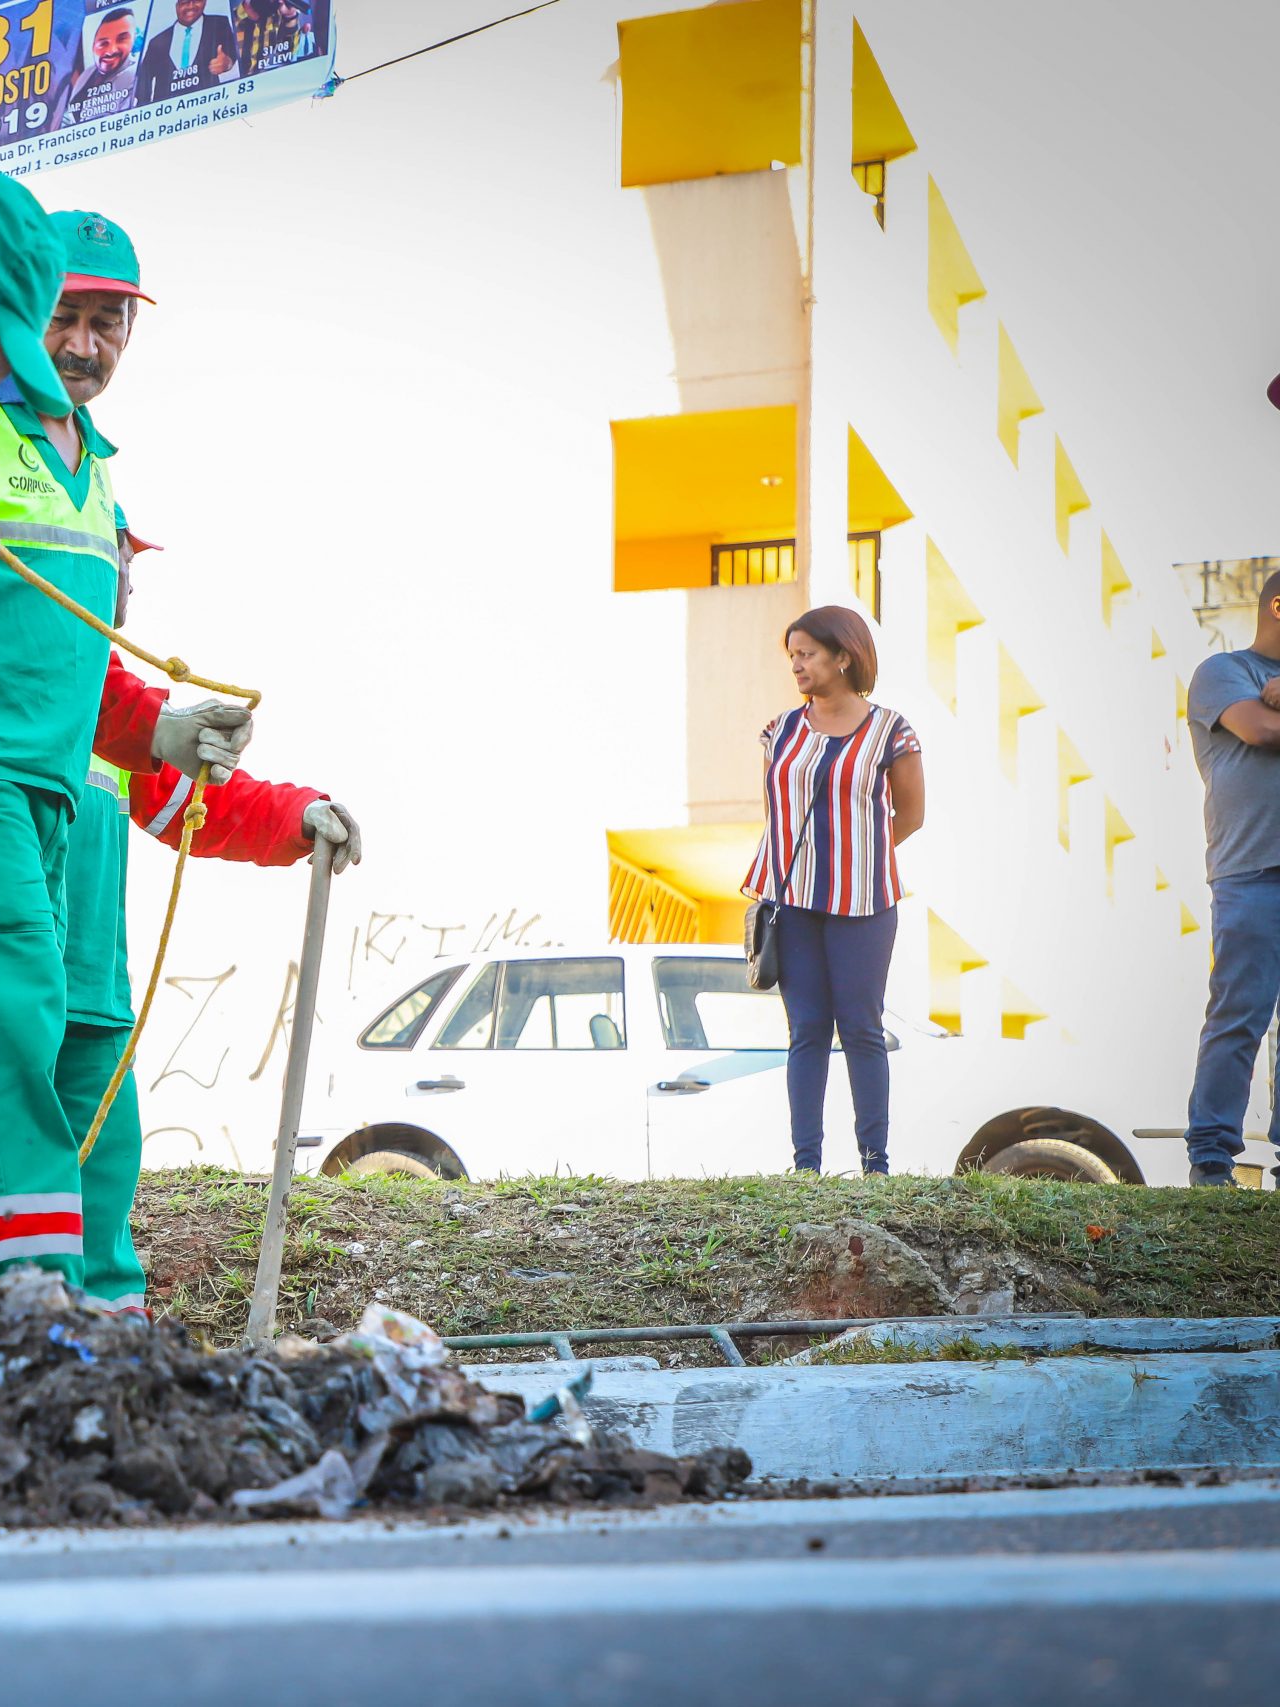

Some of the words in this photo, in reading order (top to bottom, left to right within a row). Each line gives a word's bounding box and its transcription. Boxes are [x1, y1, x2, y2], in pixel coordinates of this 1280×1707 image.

[262, 41, 290, 57] 31/08
[272, 52, 292, 66] LEVI
[172, 65, 198, 80] 29/08
[87, 83, 112, 97] 22/08
[170, 76, 200, 92] DIEGO
[82, 88, 129, 109] FERNANDO
[17, 144, 35, 157] Dr.
[38, 126, 96, 151] Francisco
[100, 109, 152, 133] Eugênio
[155, 104, 172, 117] do
[176, 87, 230, 112] Amaral,
[237, 80, 255, 94] 83
[34, 160, 42, 171] 1
[54, 144, 98, 165] Osasco
[110, 136, 135, 150] Rua
[138, 129, 154, 142] da
[158, 115, 208, 137] Padaria
[213, 102, 248, 122] Késia
[8, 476, 56, 493] CORPUS
